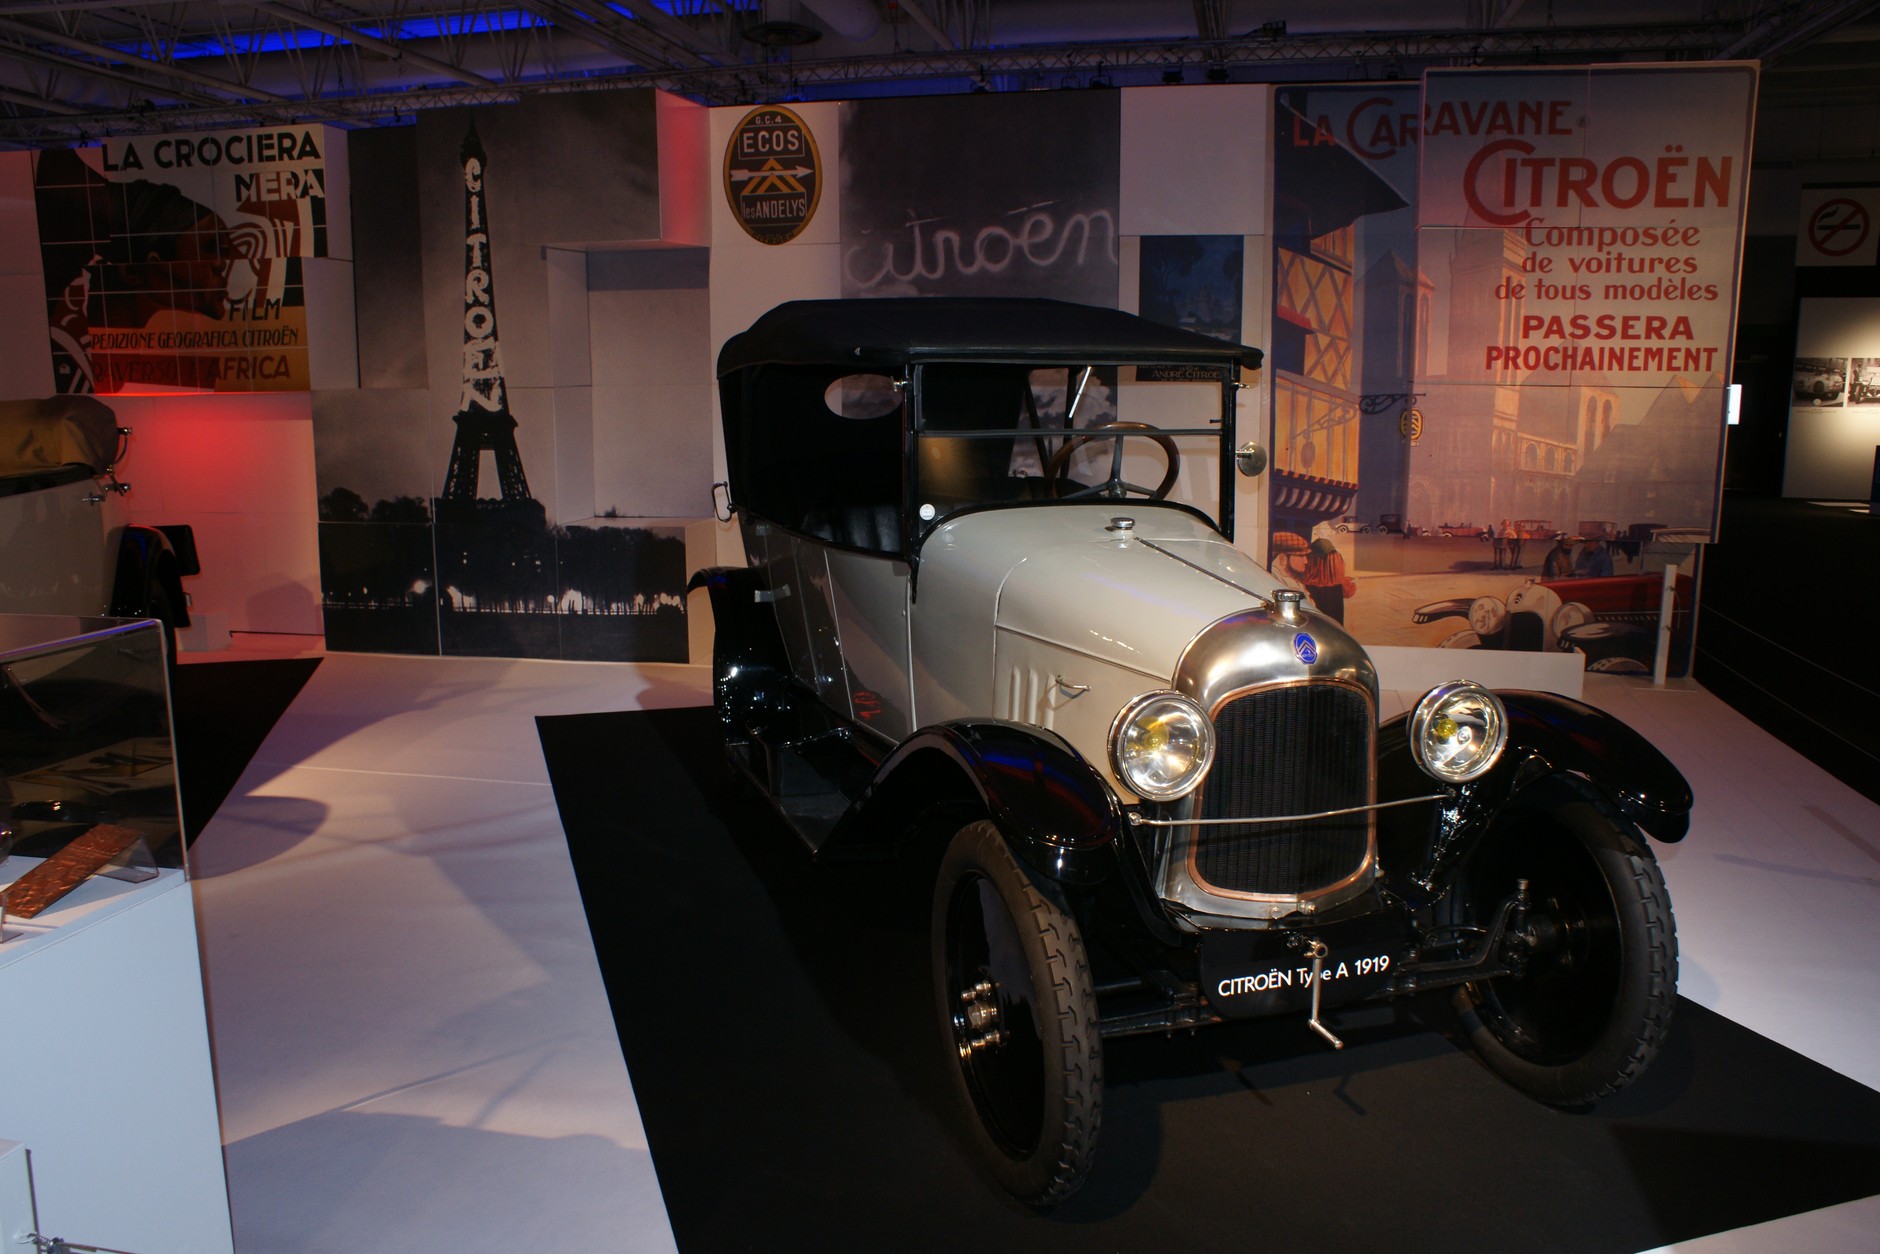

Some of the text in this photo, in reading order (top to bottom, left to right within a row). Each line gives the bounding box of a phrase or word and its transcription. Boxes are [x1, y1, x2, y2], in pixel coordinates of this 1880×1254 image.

[743, 130, 799, 153] ECOS
[1293, 97, 1573, 160] LA CARAVANE
[102, 131, 321, 172] LA CROCIERA
[234, 169, 325, 203] NERA
[1464, 139, 1733, 226] CITROËN
[756, 198, 805, 219] ANDELYS
[1524, 217, 1700, 255] Composée
[1522, 251, 1698, 274] de voitures
[1495, 276, 1718, 301] de tous modèles
[229, 298, 281, 321] FILM
[89, 325, 299, 350] PEDIZIONE GEOGRAFICA CITROËN
[1521, 314, 1695, 341] PASSERA
[1486, 346, 1718, 373] PROCHAINEMENT
[1218, 955, 1390, 997] CITROËN Tye A 1919
